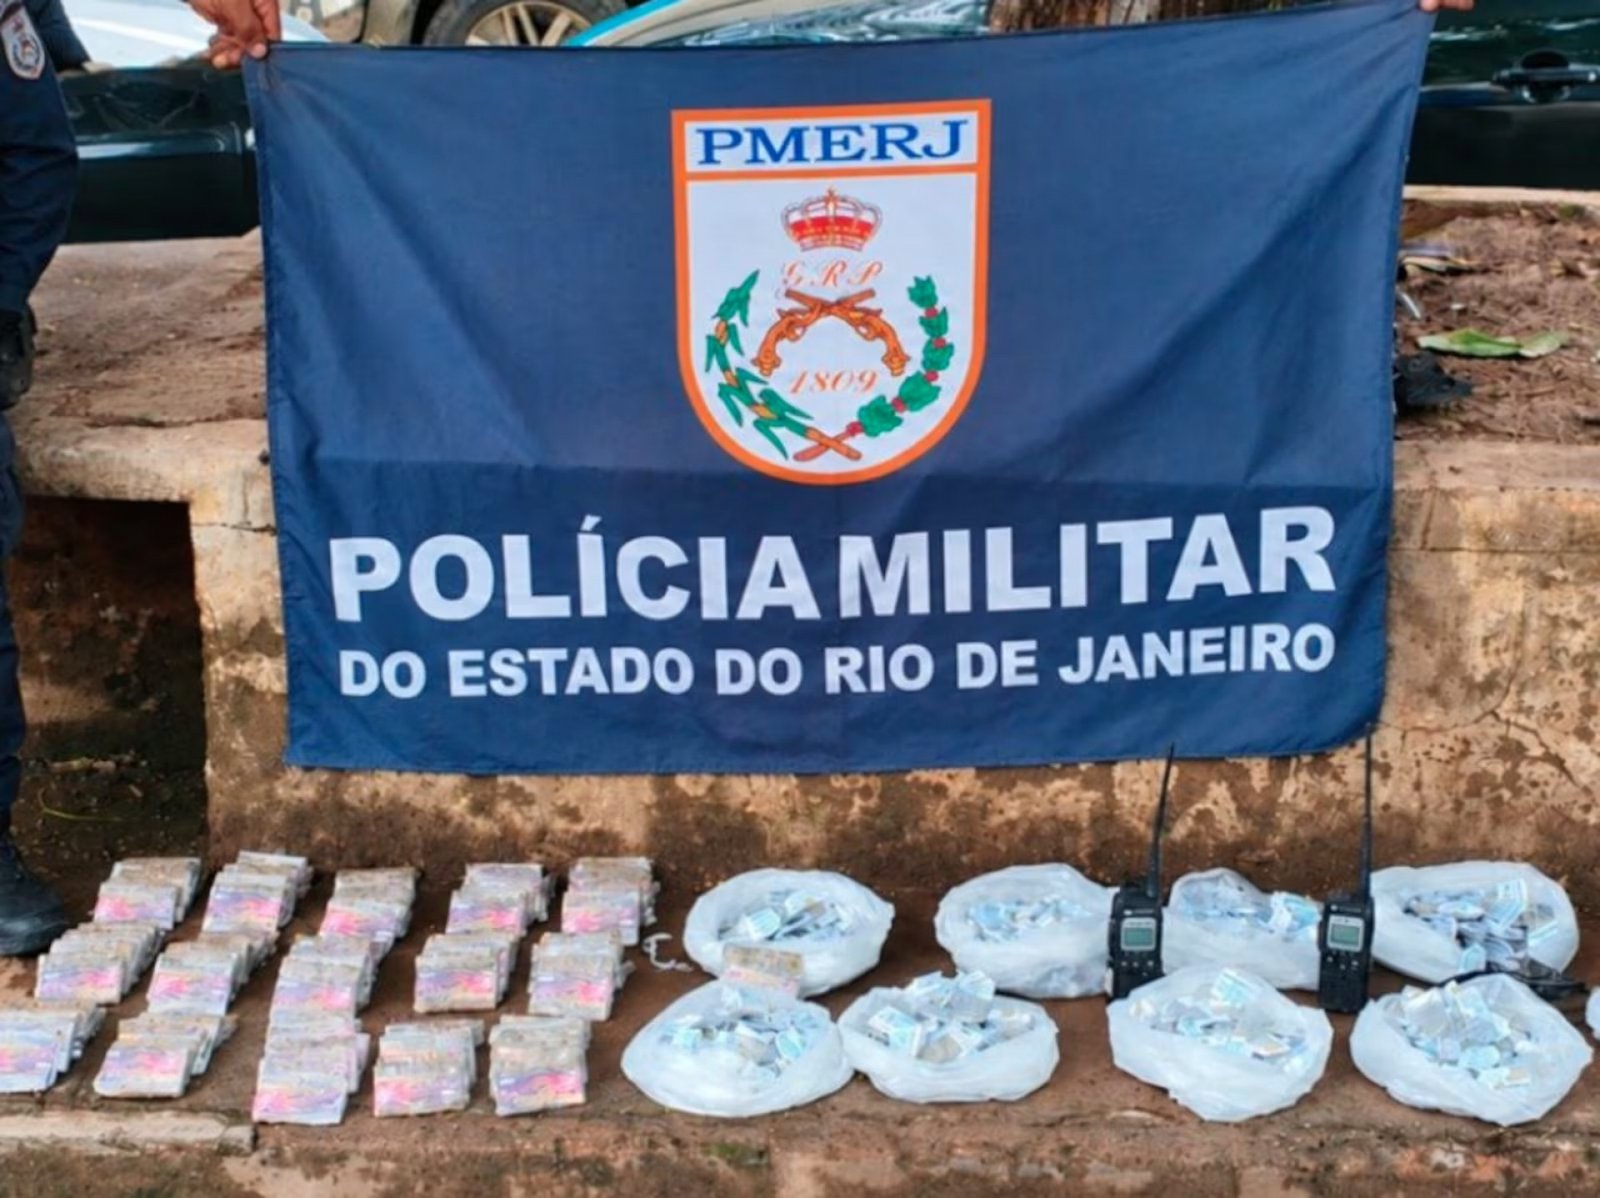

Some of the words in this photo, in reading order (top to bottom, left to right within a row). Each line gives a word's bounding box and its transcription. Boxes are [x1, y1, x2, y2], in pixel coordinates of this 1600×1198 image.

[695, 119, 969, 165] PMERJ
[789, 369, 878, 394] 1809
[329, 515, 821, 622] POLÍCIA
[839, 506, 1336, 618] MILITAR
[340, 650, 426, 698] DO
[448, 647, 694, 697] ESTADO
[715, 647, 802, 695] DO
[825, 644, 934, 694] RIO
[957, 640, 1038, 689] DE
[1058, 623, 1335, 684] JANEIRO
